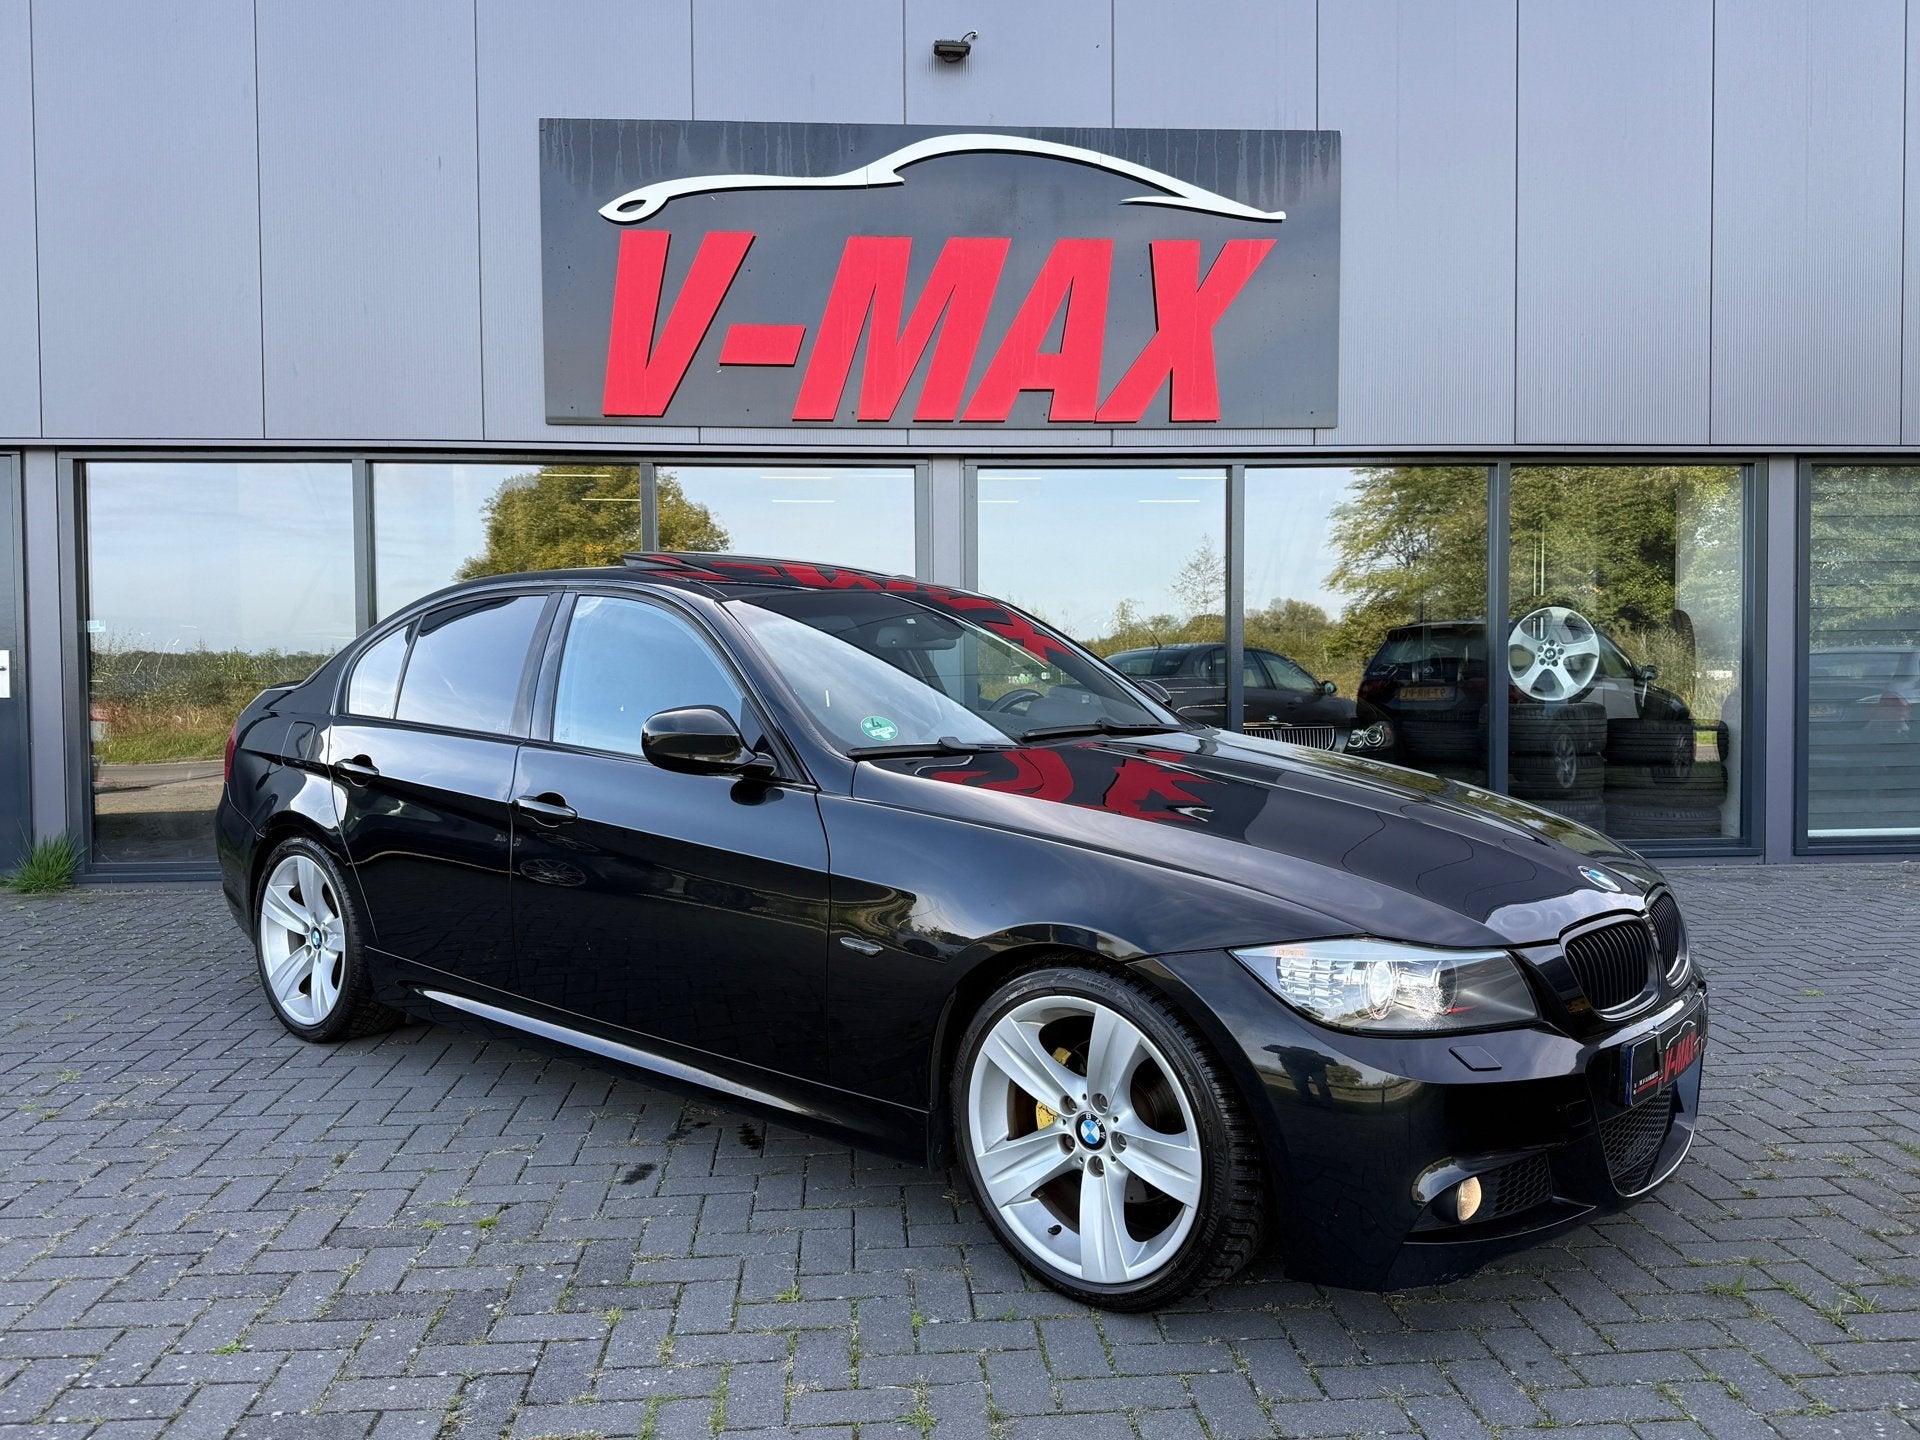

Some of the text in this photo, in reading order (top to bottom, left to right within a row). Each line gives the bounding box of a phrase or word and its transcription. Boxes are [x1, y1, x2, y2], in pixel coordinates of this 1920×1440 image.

[602, 229, 1278, 424] V-MAX
[871, 718, 882, 728] 4
[1085, 1113, 1106, 1140] BMW
